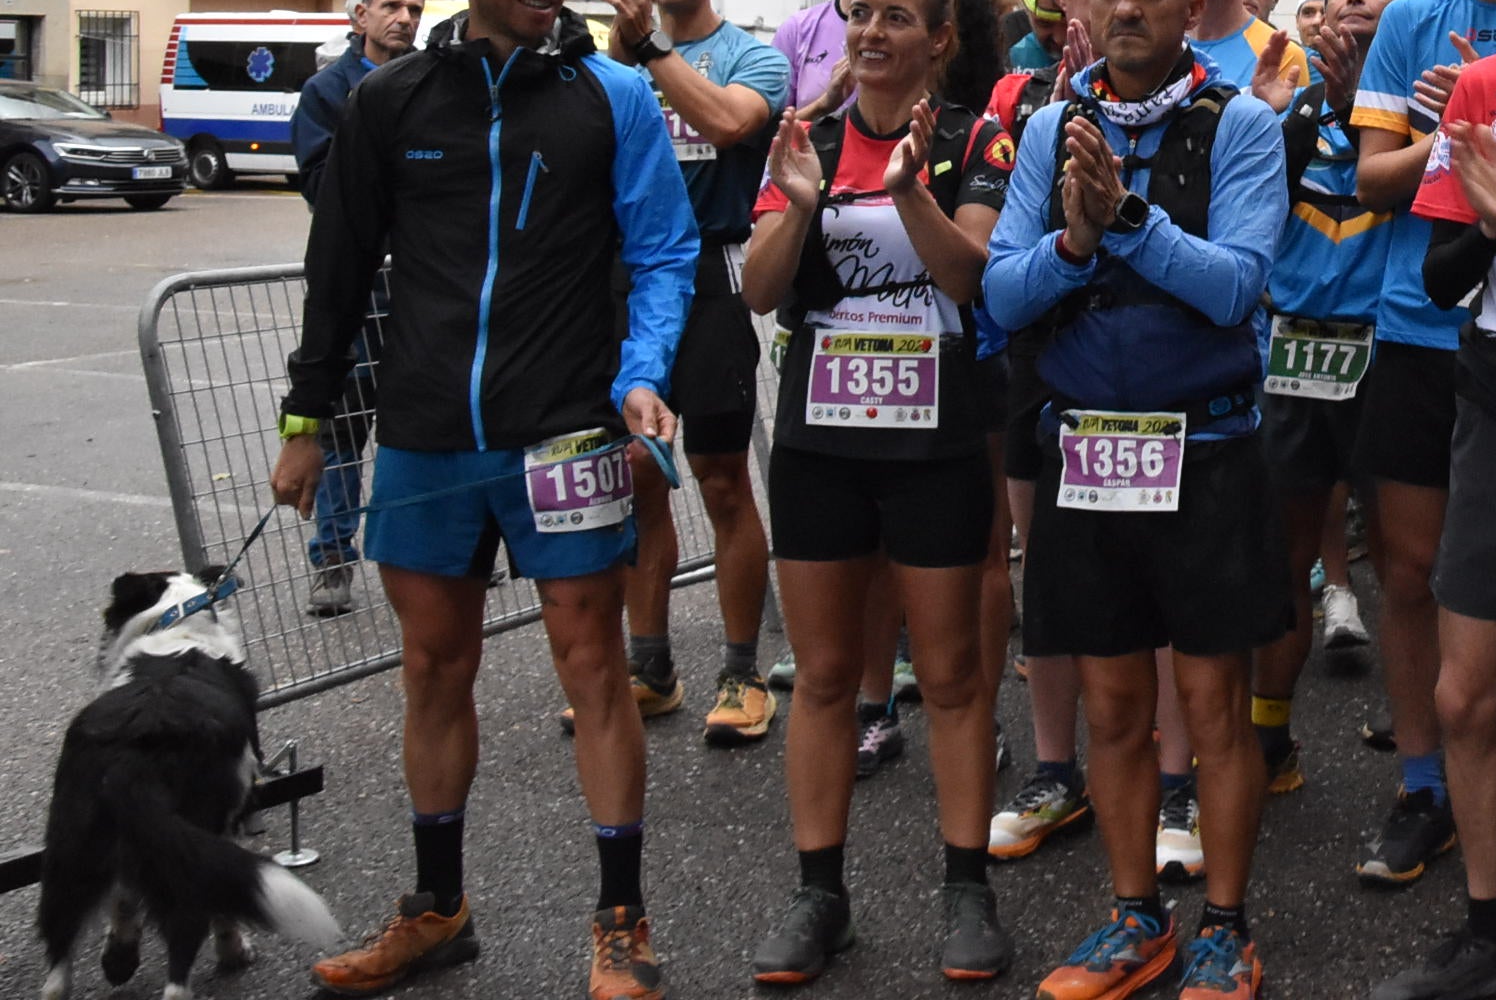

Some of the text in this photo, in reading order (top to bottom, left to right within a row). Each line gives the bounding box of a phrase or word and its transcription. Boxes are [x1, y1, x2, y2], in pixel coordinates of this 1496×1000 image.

[868, 310, 923, 325] Premium
[854, 338, 894, 353] VETONA
[897, 339, 926, 353] 202
[1283, 340, 1357, 375] 1177
[826, 357, 920, 397] 1355
[859, 396, 884, 405] CASTY
[1074, 438, 1165, 478] 1356
[546, 452, 624, 502] 1507
